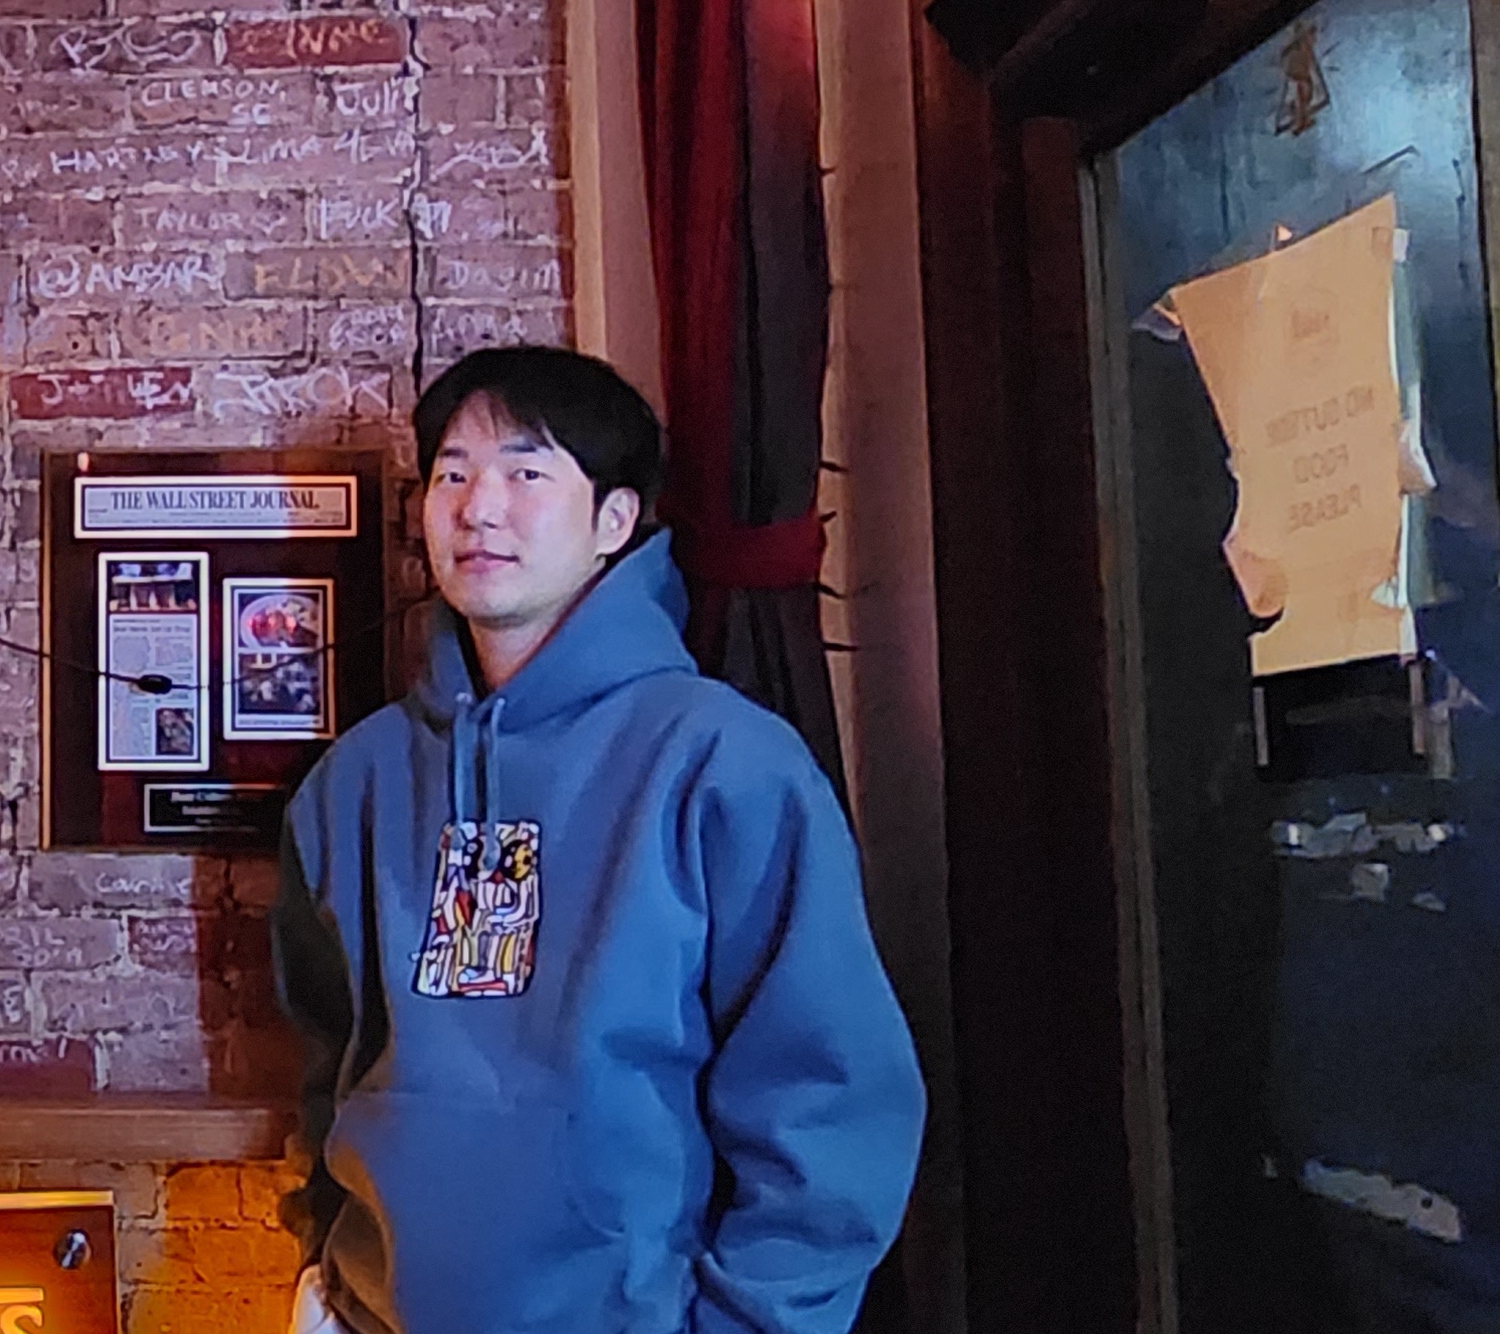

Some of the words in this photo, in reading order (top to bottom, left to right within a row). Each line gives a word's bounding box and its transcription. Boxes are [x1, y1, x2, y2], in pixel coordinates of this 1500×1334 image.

[110, 491, 143, 510] THE
[146, 491, 187, 510] WALL
[188, 491, 247, 509] STREET
